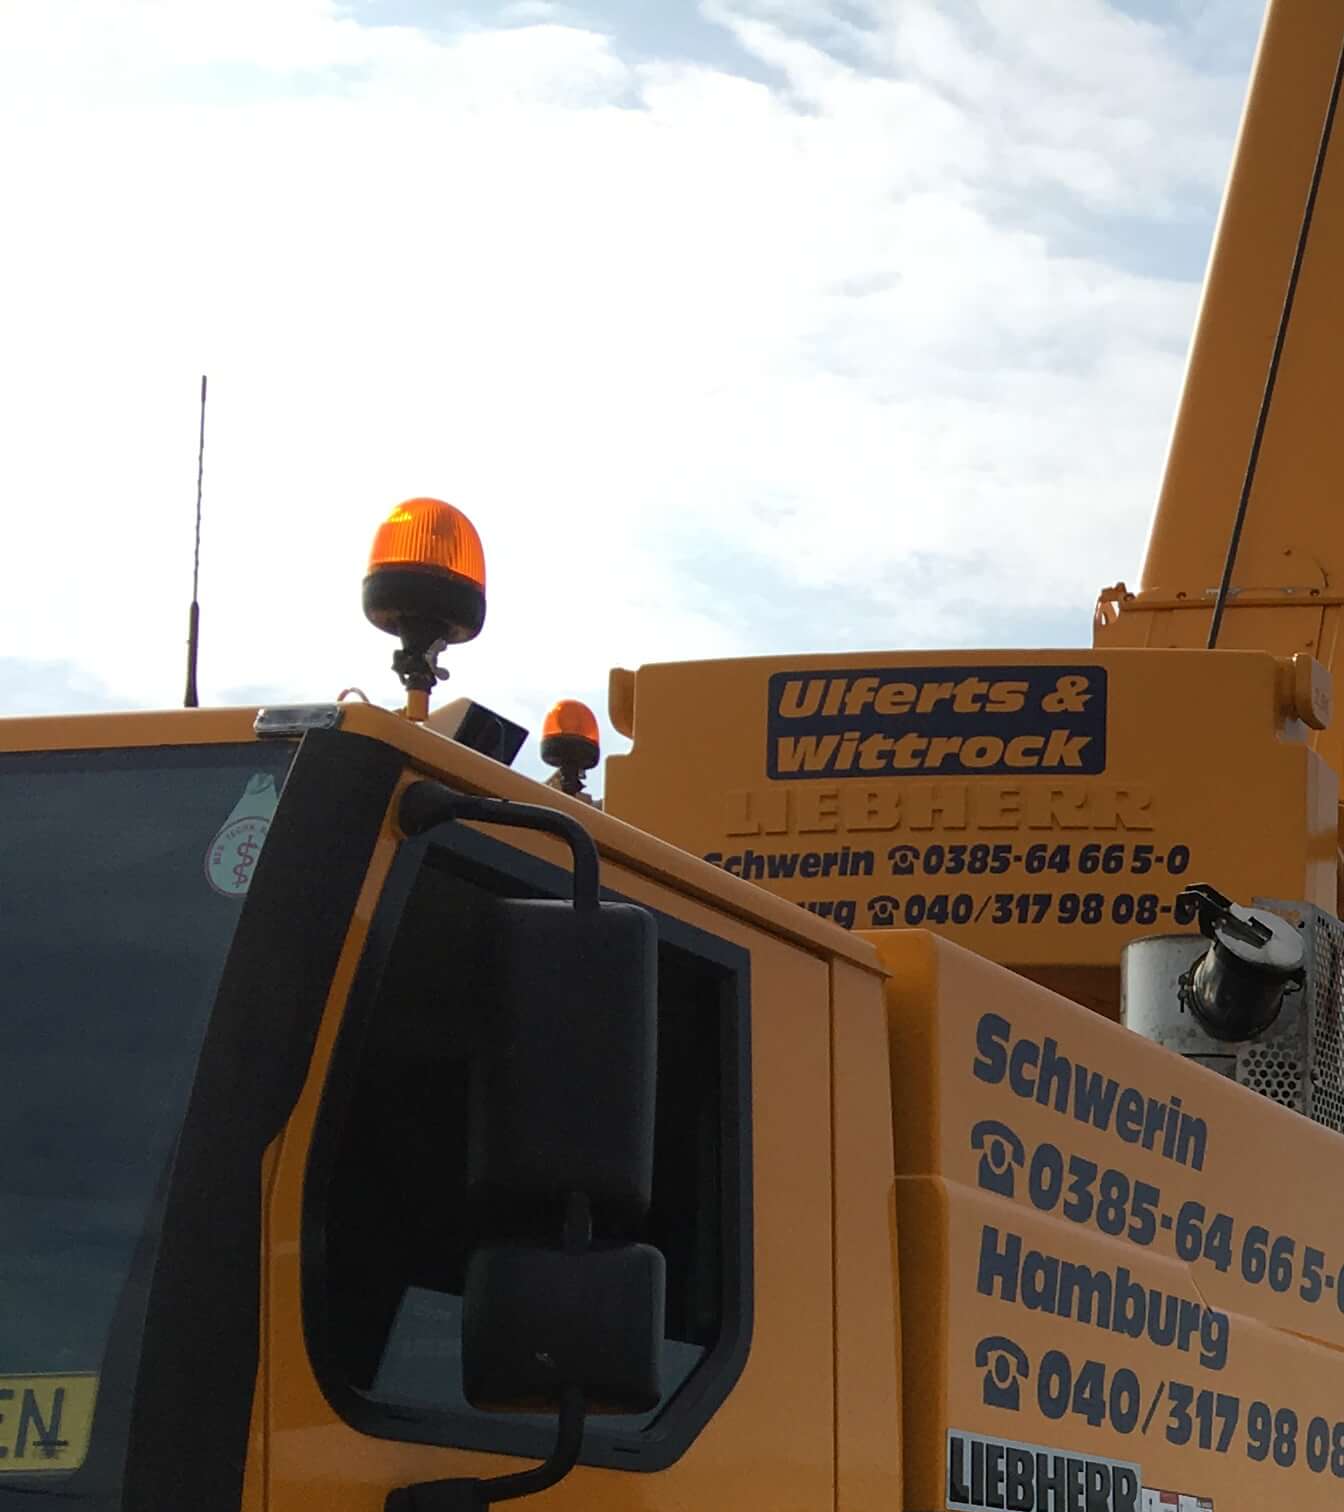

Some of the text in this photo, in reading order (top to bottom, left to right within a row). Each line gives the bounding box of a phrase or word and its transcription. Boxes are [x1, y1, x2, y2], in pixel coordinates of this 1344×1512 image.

[778, 675, 1093, 719] Ulferts &
[776, 729, 1091, 773] Wittrock
[725, 783, 1155, 838] LIEBHERR
[973, 1013, 1209, 1172] Schwerin
[976, 1226, 1230, 1371] Hamburg
